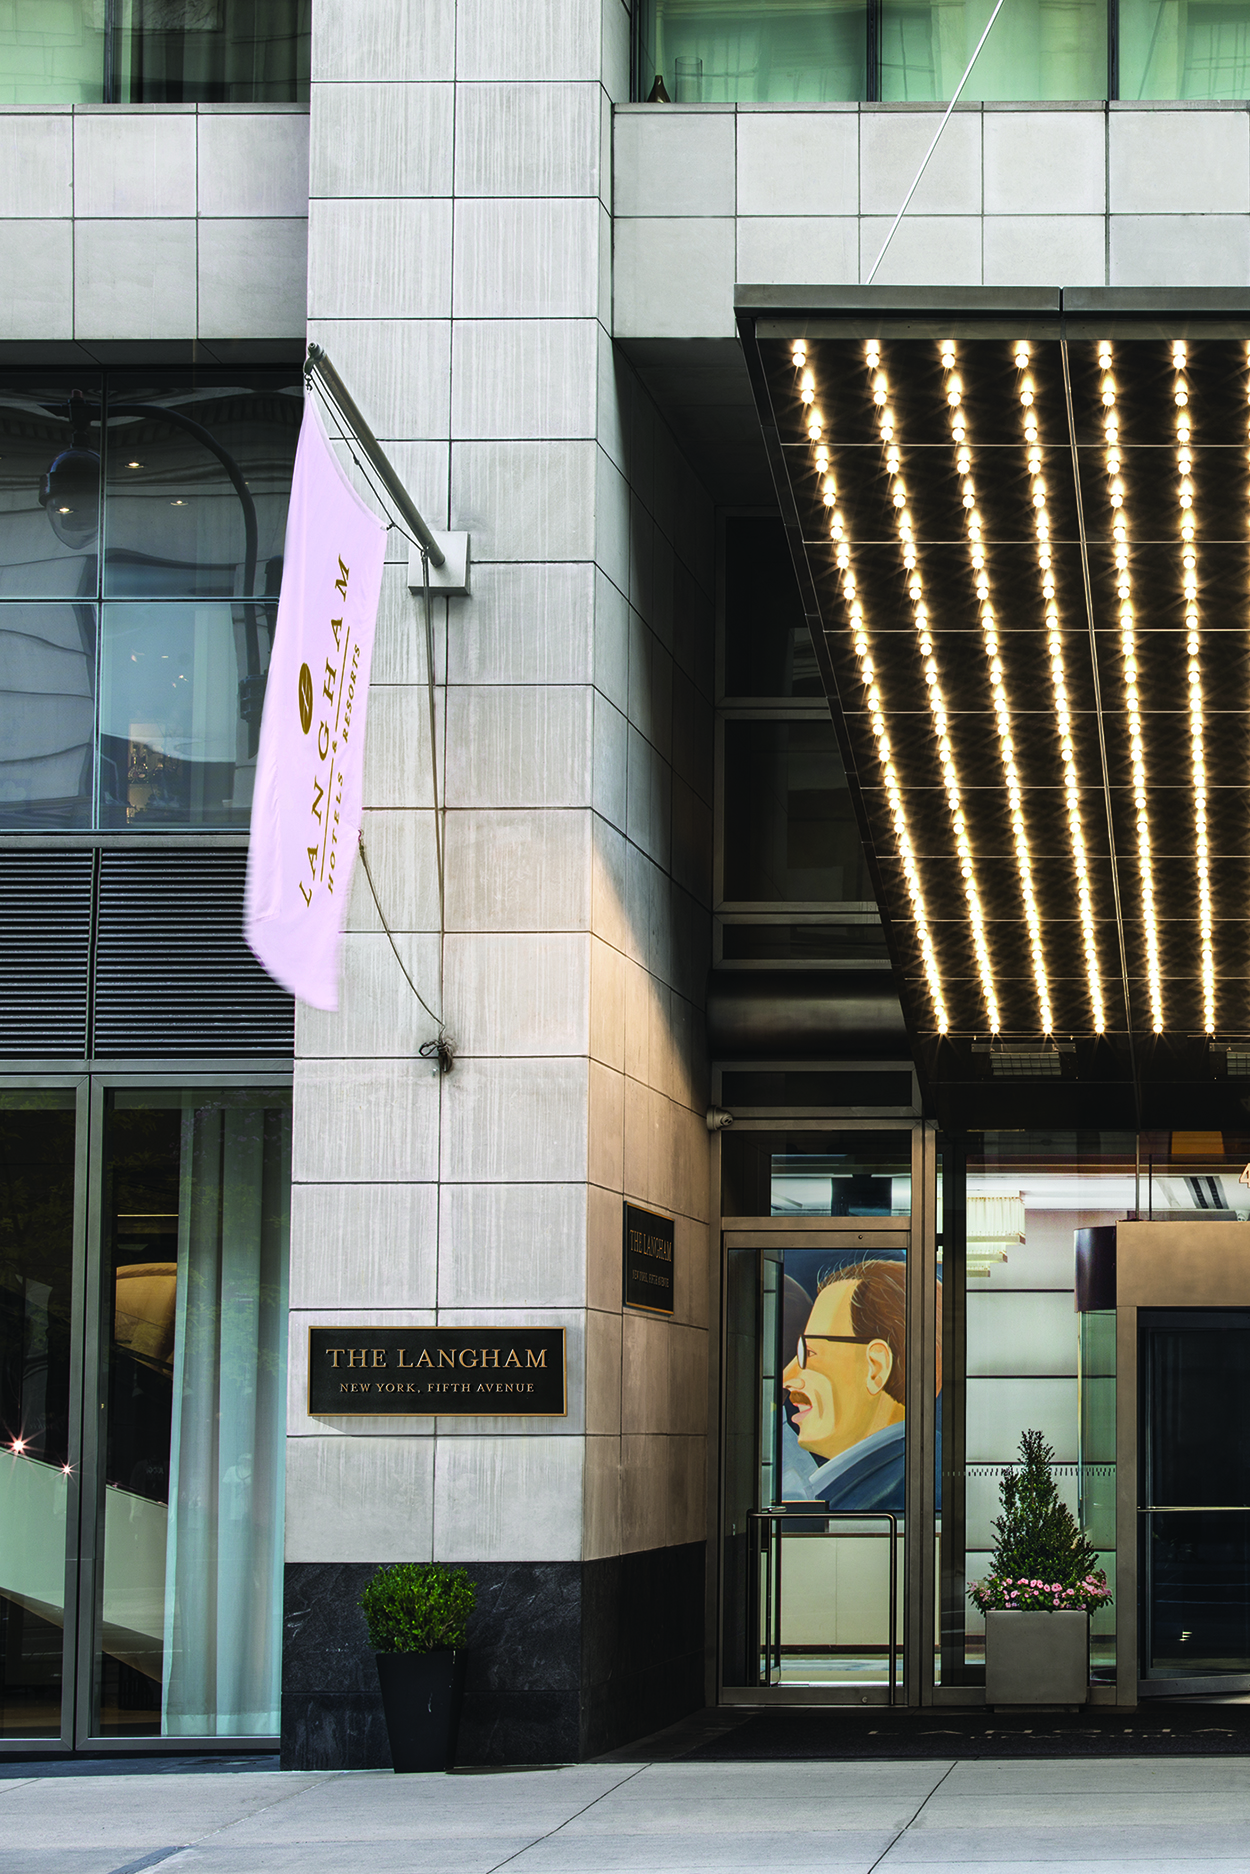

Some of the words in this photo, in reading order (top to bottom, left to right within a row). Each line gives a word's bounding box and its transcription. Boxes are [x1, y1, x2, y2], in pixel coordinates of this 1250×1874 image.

[299, 553, 349, 907] LANGHAM
[327, 772, 343, 894] HOTELS
[342, 644, 360, 744] RESORTS
[326, 1349, 387, 1368] THE
[397, 1349, 548, 1368] LANGHAM
[340, 1383, 371, 1393] NEW
[376, 1383, 421, 1394] YORK,
[427, 1383, 471, 1393] FIFTH
[476, 1383, 535, 1393] AVENUE
